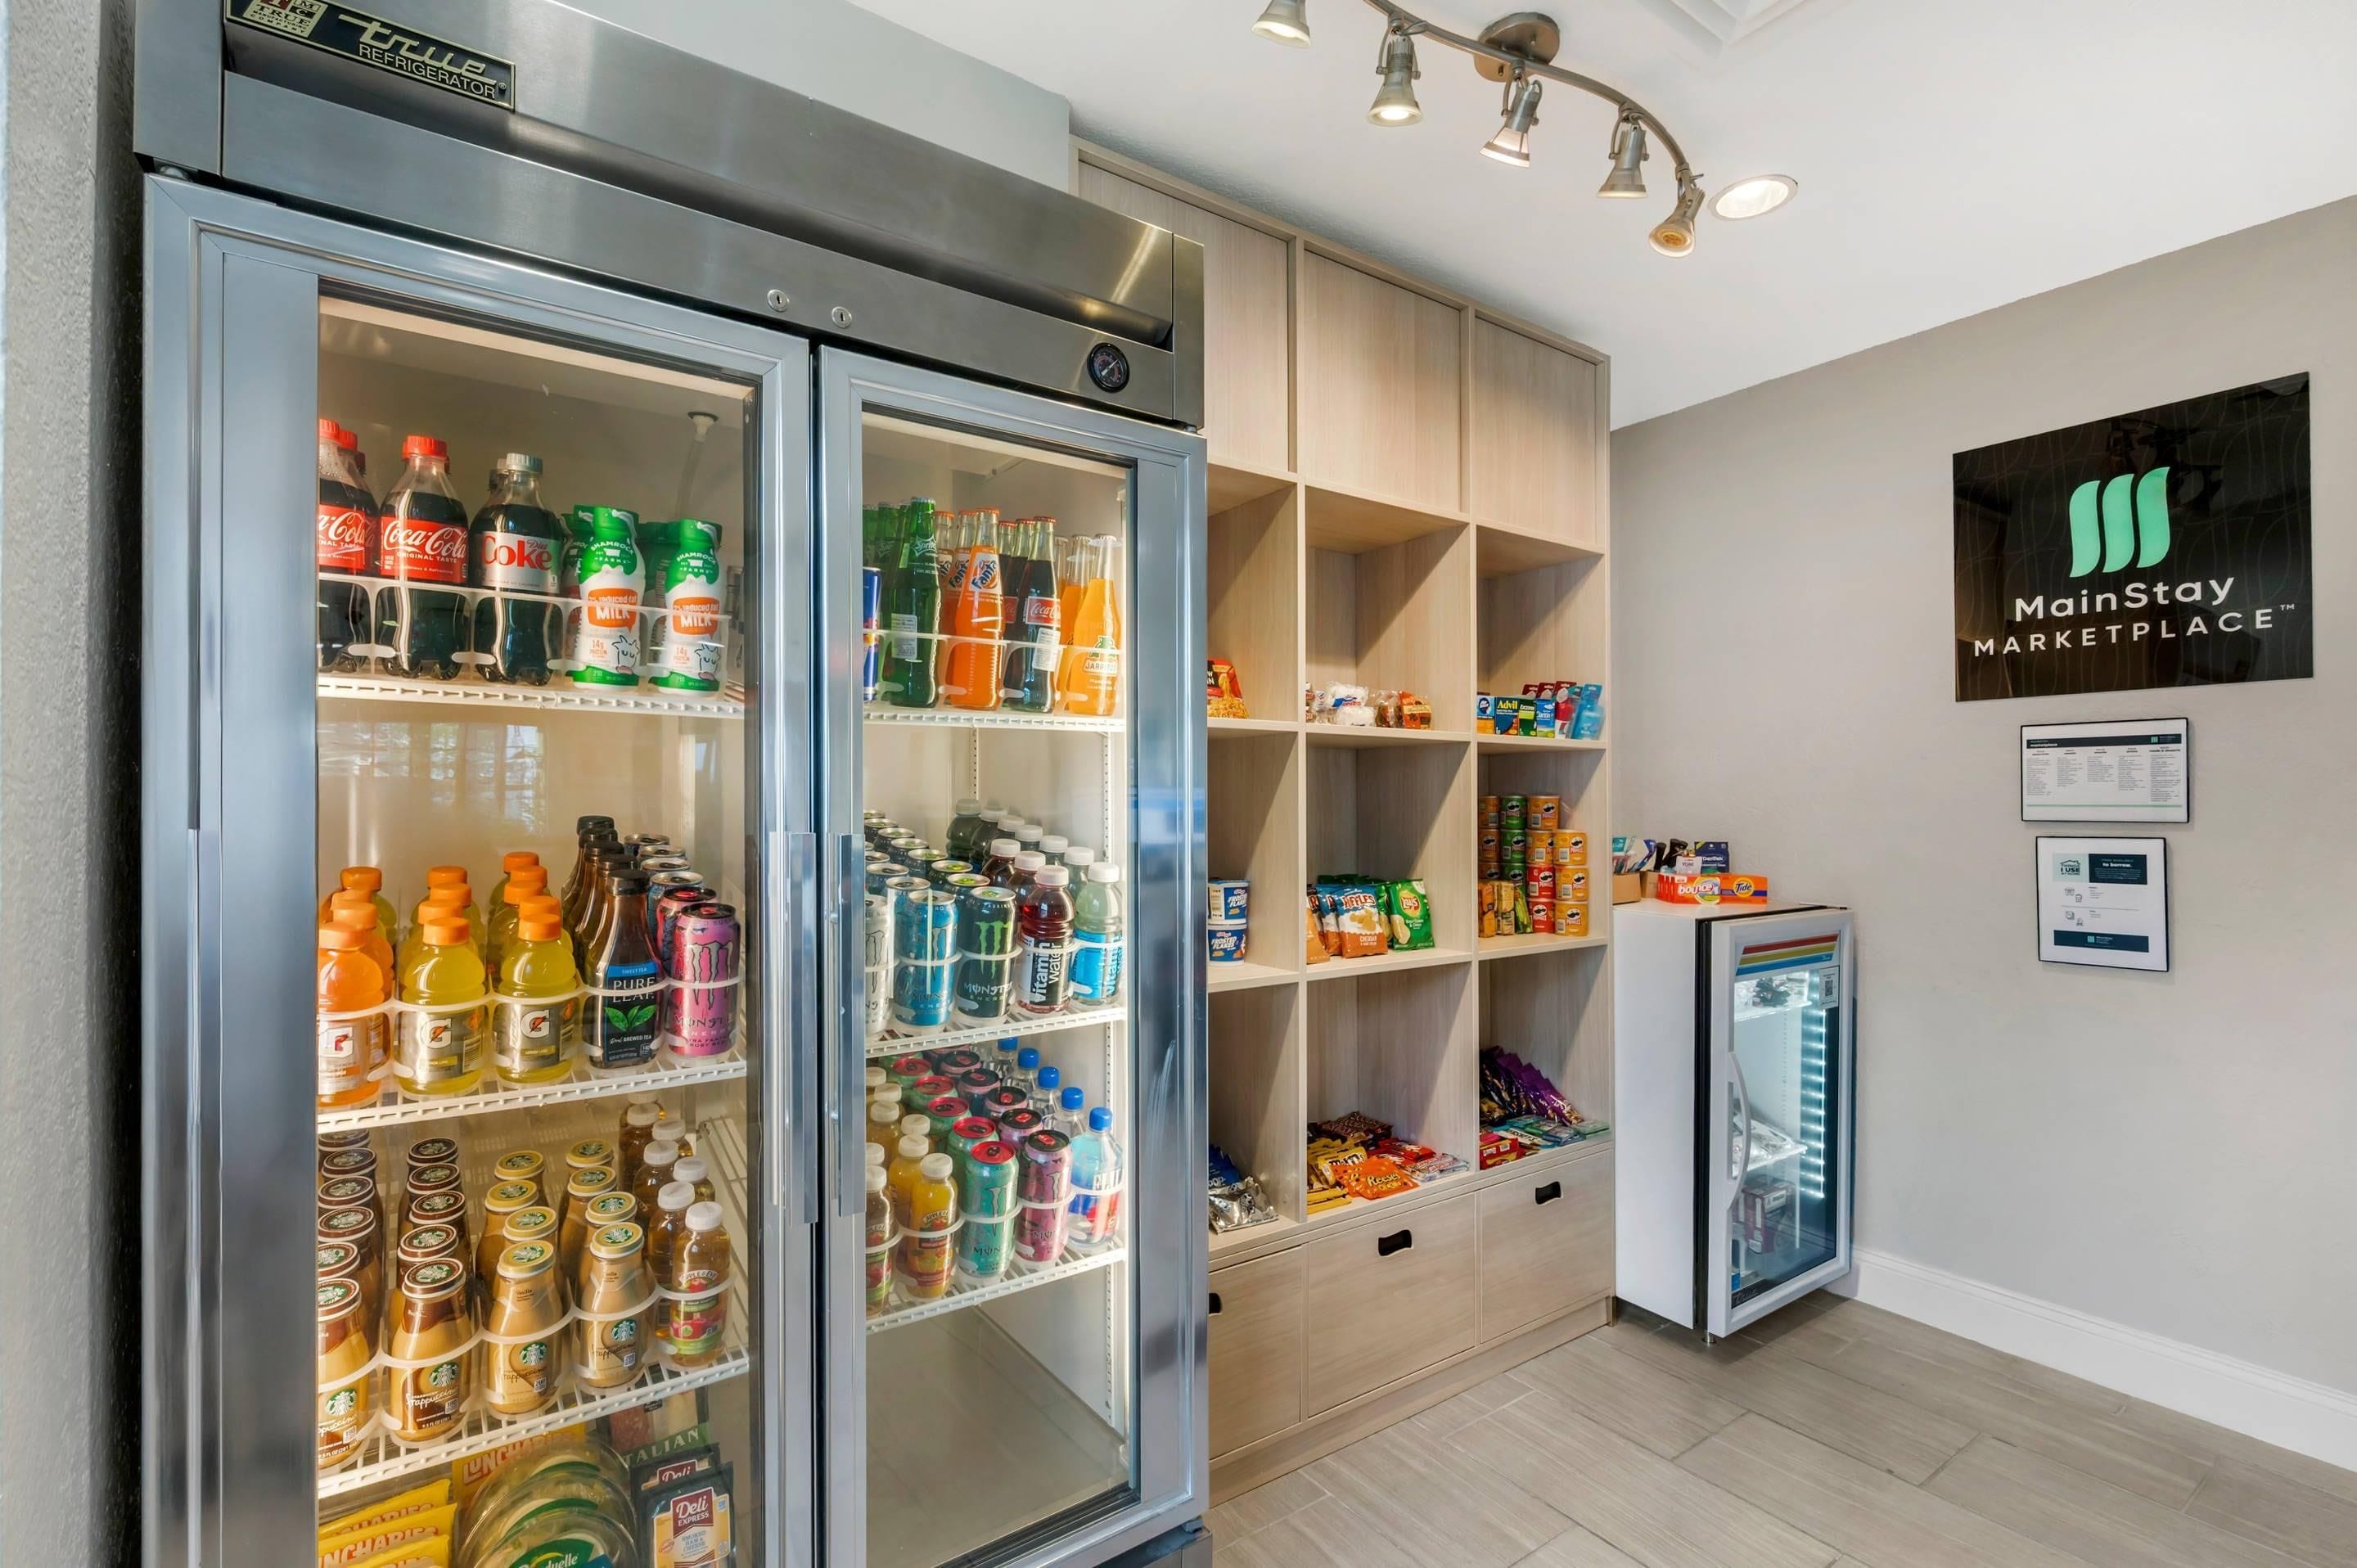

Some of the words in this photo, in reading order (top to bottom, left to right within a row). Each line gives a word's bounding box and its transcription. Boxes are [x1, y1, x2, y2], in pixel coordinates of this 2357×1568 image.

[250, 14, 306, 34] COMPANY
[255, 4, 311, 27] TRUE
[358, 43, 496, 100] REFRIGERATOR
[383, 520, 468, 559] Coca-Cola
[590, 540, 634, 554] SHAMROCK
[396, 552, 434, 561] ORIGINAL
[435, 556, 457, 564] TASTE
[481, 535, 553, 571] Coke
[676, 552, 716, 565] SHAMROCK
[971, 560, 998, 590] Fanta
[2015, 577, 2235, 622] MainStay
[596, 606, 631, 620] MILK
[680, 612, 712, 628] MILK
[1497, 700, 1518, 710] Advil
[1679, 882, 1715, 894] bounce
[1734, 882, 1753, 893] Tide
[1032, 940, 1051, 1003] vitamin
[1048, 943, 1062, 984] water
[622, 1428, 701, 1467] TALIAN
[675, 1495, 708, 1520] Deli
[678, 1510, 710, 1527] EXPRESS
